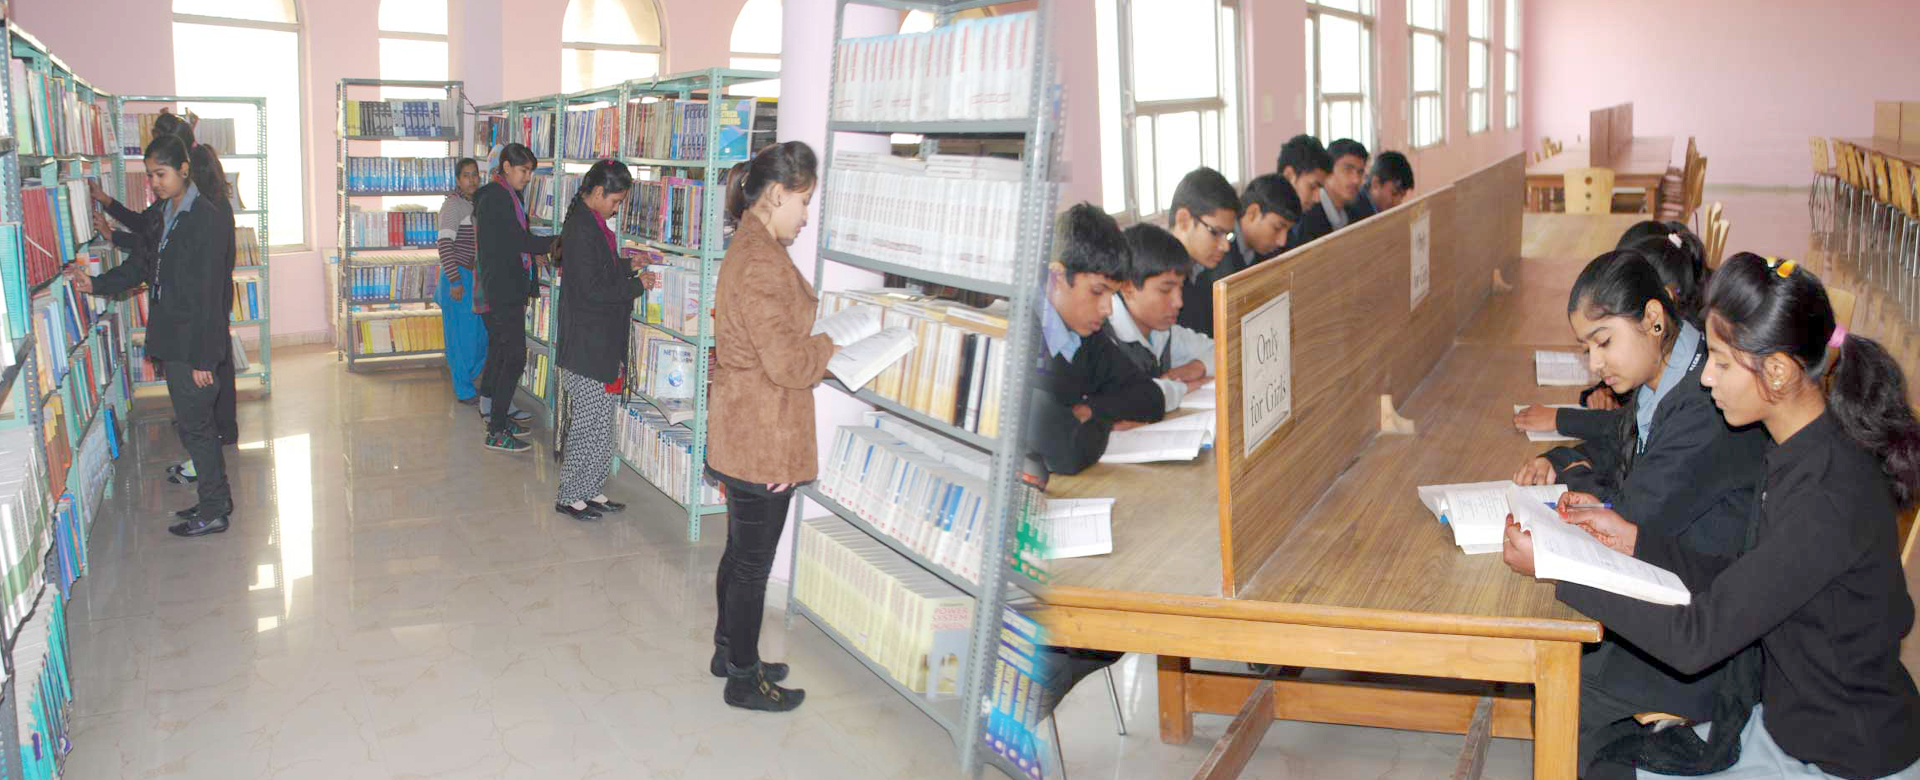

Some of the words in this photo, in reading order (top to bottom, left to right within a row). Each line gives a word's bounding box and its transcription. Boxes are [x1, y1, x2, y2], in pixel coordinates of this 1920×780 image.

[1257, 327, 1278, 364] Only
[1250, 395, 1263, 427] for
[1266, 373, 1286, 412] Girls
